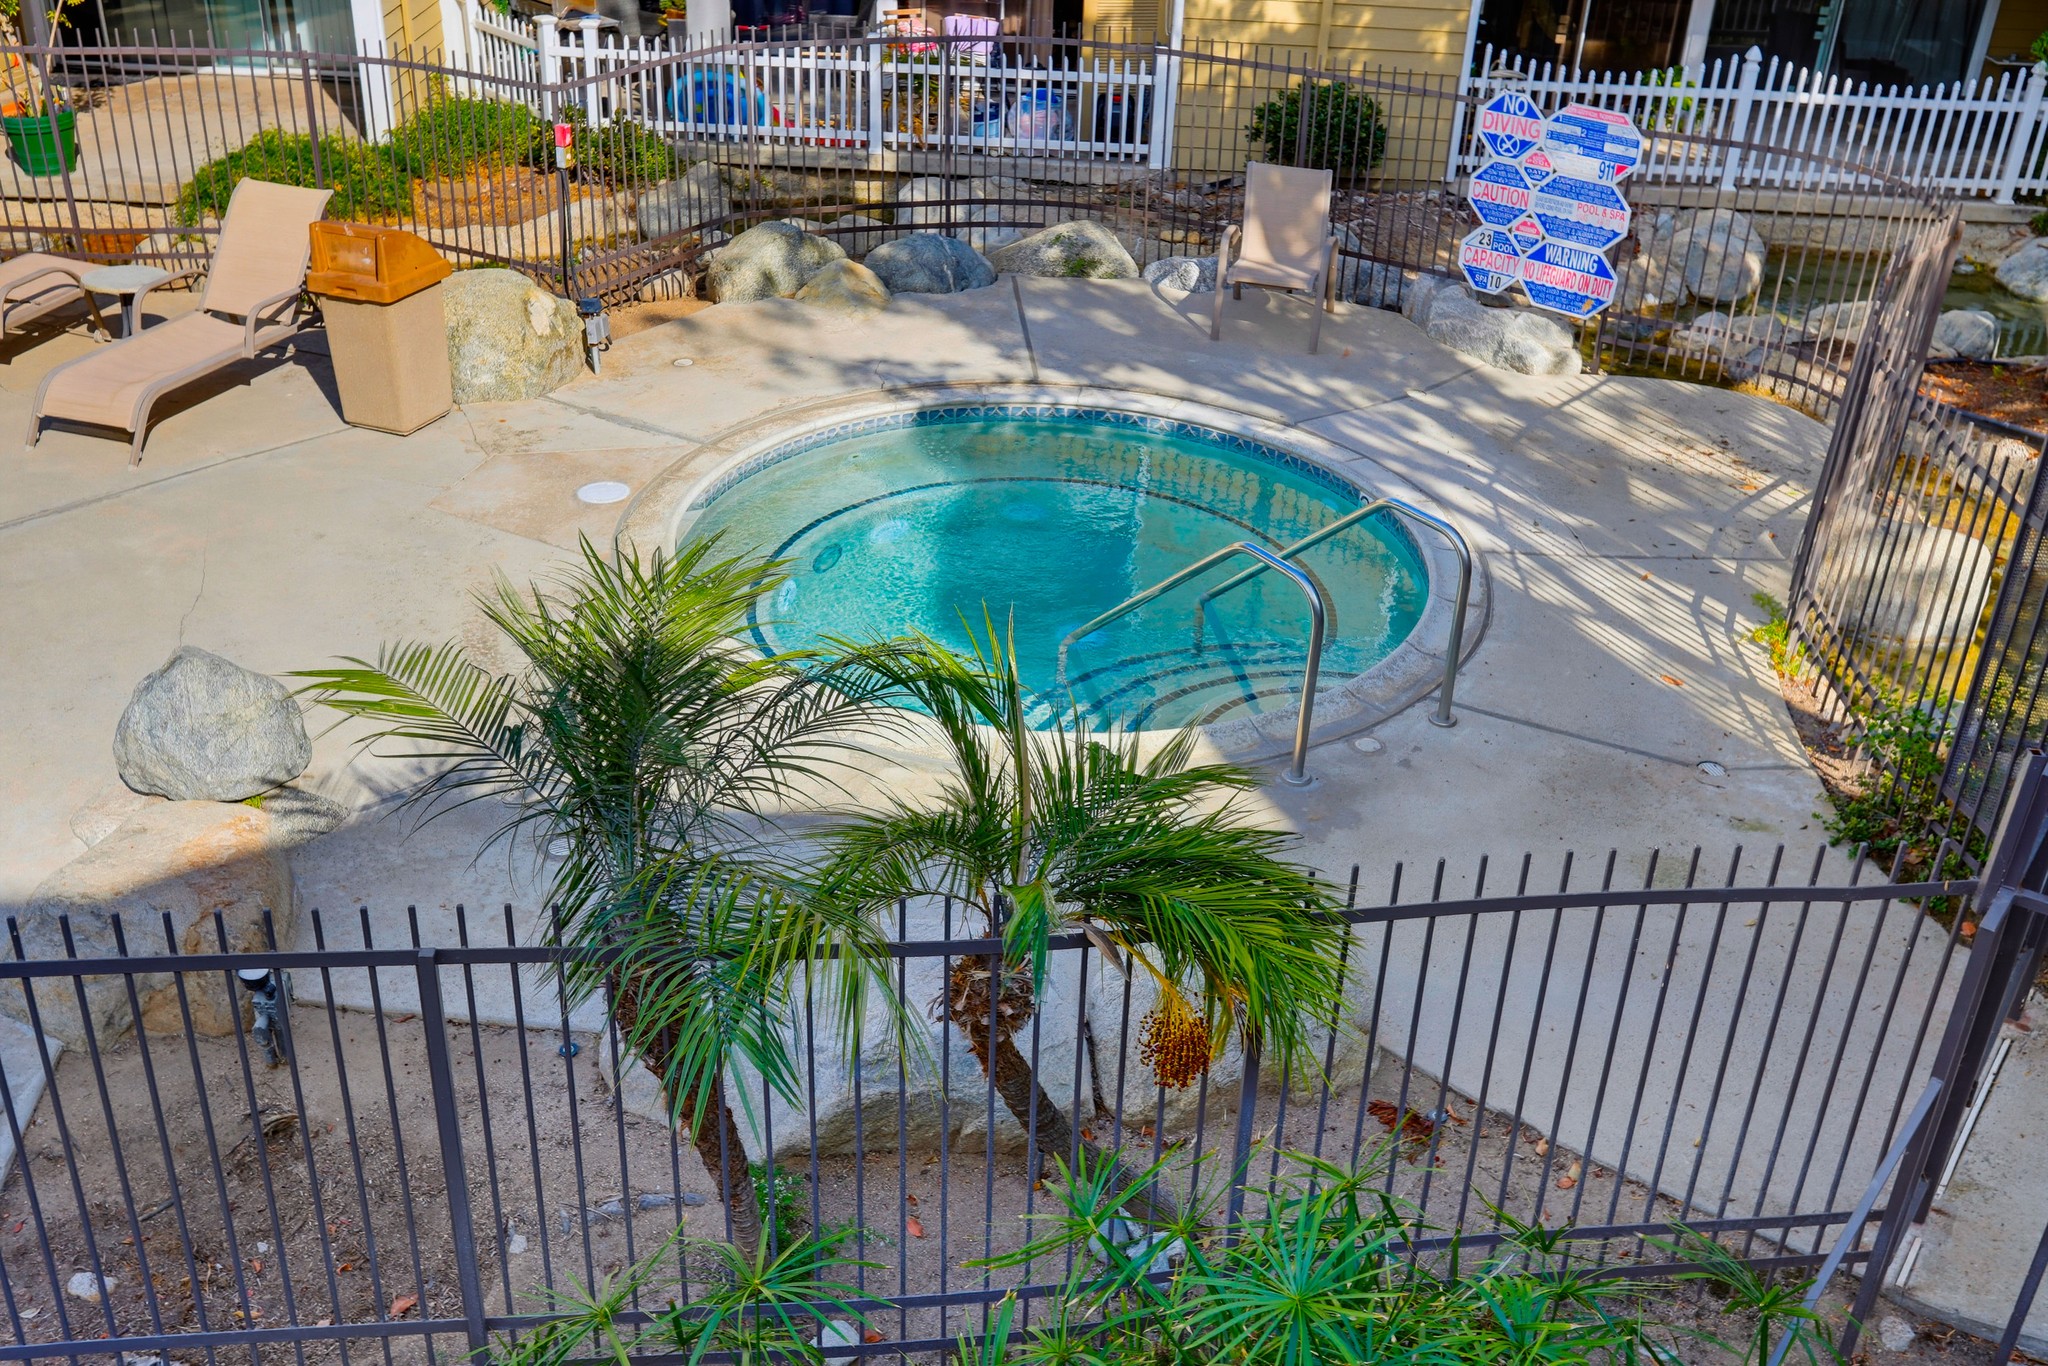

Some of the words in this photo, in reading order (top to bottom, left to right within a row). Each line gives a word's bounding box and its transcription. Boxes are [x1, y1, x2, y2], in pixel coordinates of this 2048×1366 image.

[1503, 94, 1528, 116] NO
[1483, 111, 1541, 138] DIVING
[1546, 130, 1551, 138] 3
[1581, 129, 1587, 137] 2
[1579, 146, 1584, 154] 4
[1527, 168, 1547, 176] GATE
[1598, 162, 1616, 181] 911
[1473, 182, 1530, 208] CAUTION
[1577, 203, 1599, 216] POOL
[1602, 208, 1607, 217] &
[1610, 210, 1625, 221] SPA
[1479, 233, 1492, 246] 23
[1493, 243, 1514, 254] POOL
[1464, 247, 1520, 275] CAPACITY
[1545, 243, 1599, 273] WARNING
[1475, 274, 1487, 283] SPA
[1490, 275, 1501, 288] 10
[1523, 261, 1535, 279] NO
[1536, 263, 1576, 289] LIFEGUARD
[1578, 273, 1591, 292] ON
[1591, 277, 1614, 298] DUTY
